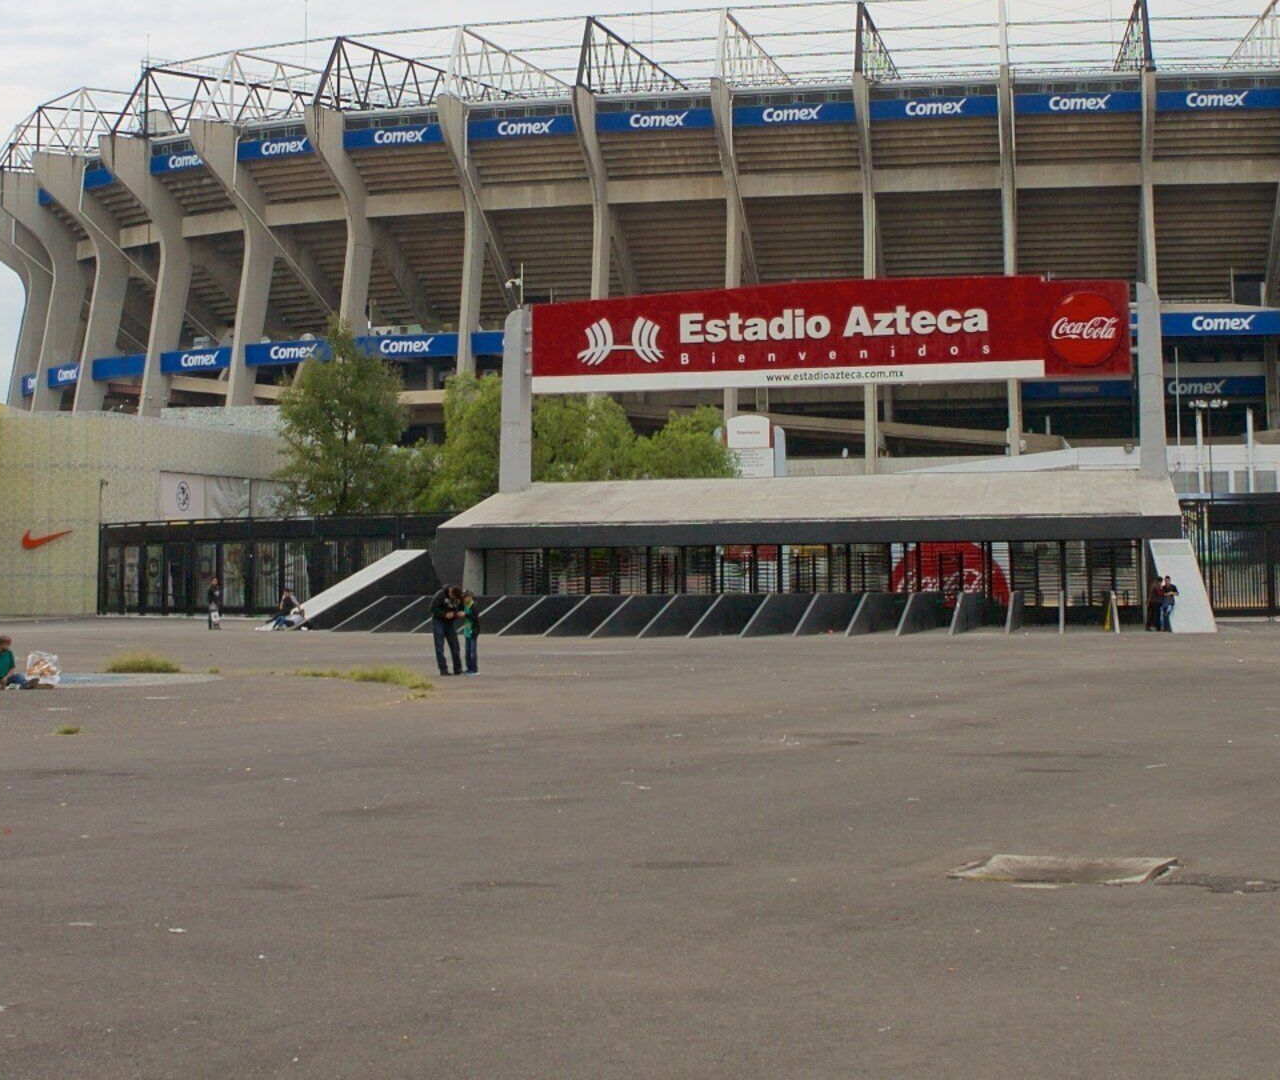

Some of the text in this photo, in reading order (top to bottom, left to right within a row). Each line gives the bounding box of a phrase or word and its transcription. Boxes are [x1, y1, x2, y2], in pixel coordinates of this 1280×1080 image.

[906, 98, 967, 116] Comex
[1049, 94, 1111, 111] Comex
[1186, 91, 1249, 108] Comex
[629, 111, 689, 128] Comex
[763, 104, 823, 122] Comex
[373, 126, 428, 144] Comex
[496, 118, 556, 136] Comex
[261, 137, 308, 156] Comex
[679, 305, 989, 344] Estadio Azteca
[1051, 316, 1120, 340] Coca-Cola
[1191, 314, 1256, 331] Comex
[269, 343, 318, 360] Comex
[379, 337, 434, 354] Comex
[180, 350, 219, 367] Comex
[680, 344, 991, 365] Bienvenidos
[766, 370, 904, 383] www.estadioazteca.com.mx
[1167, 379, 1227, 395] Comex
